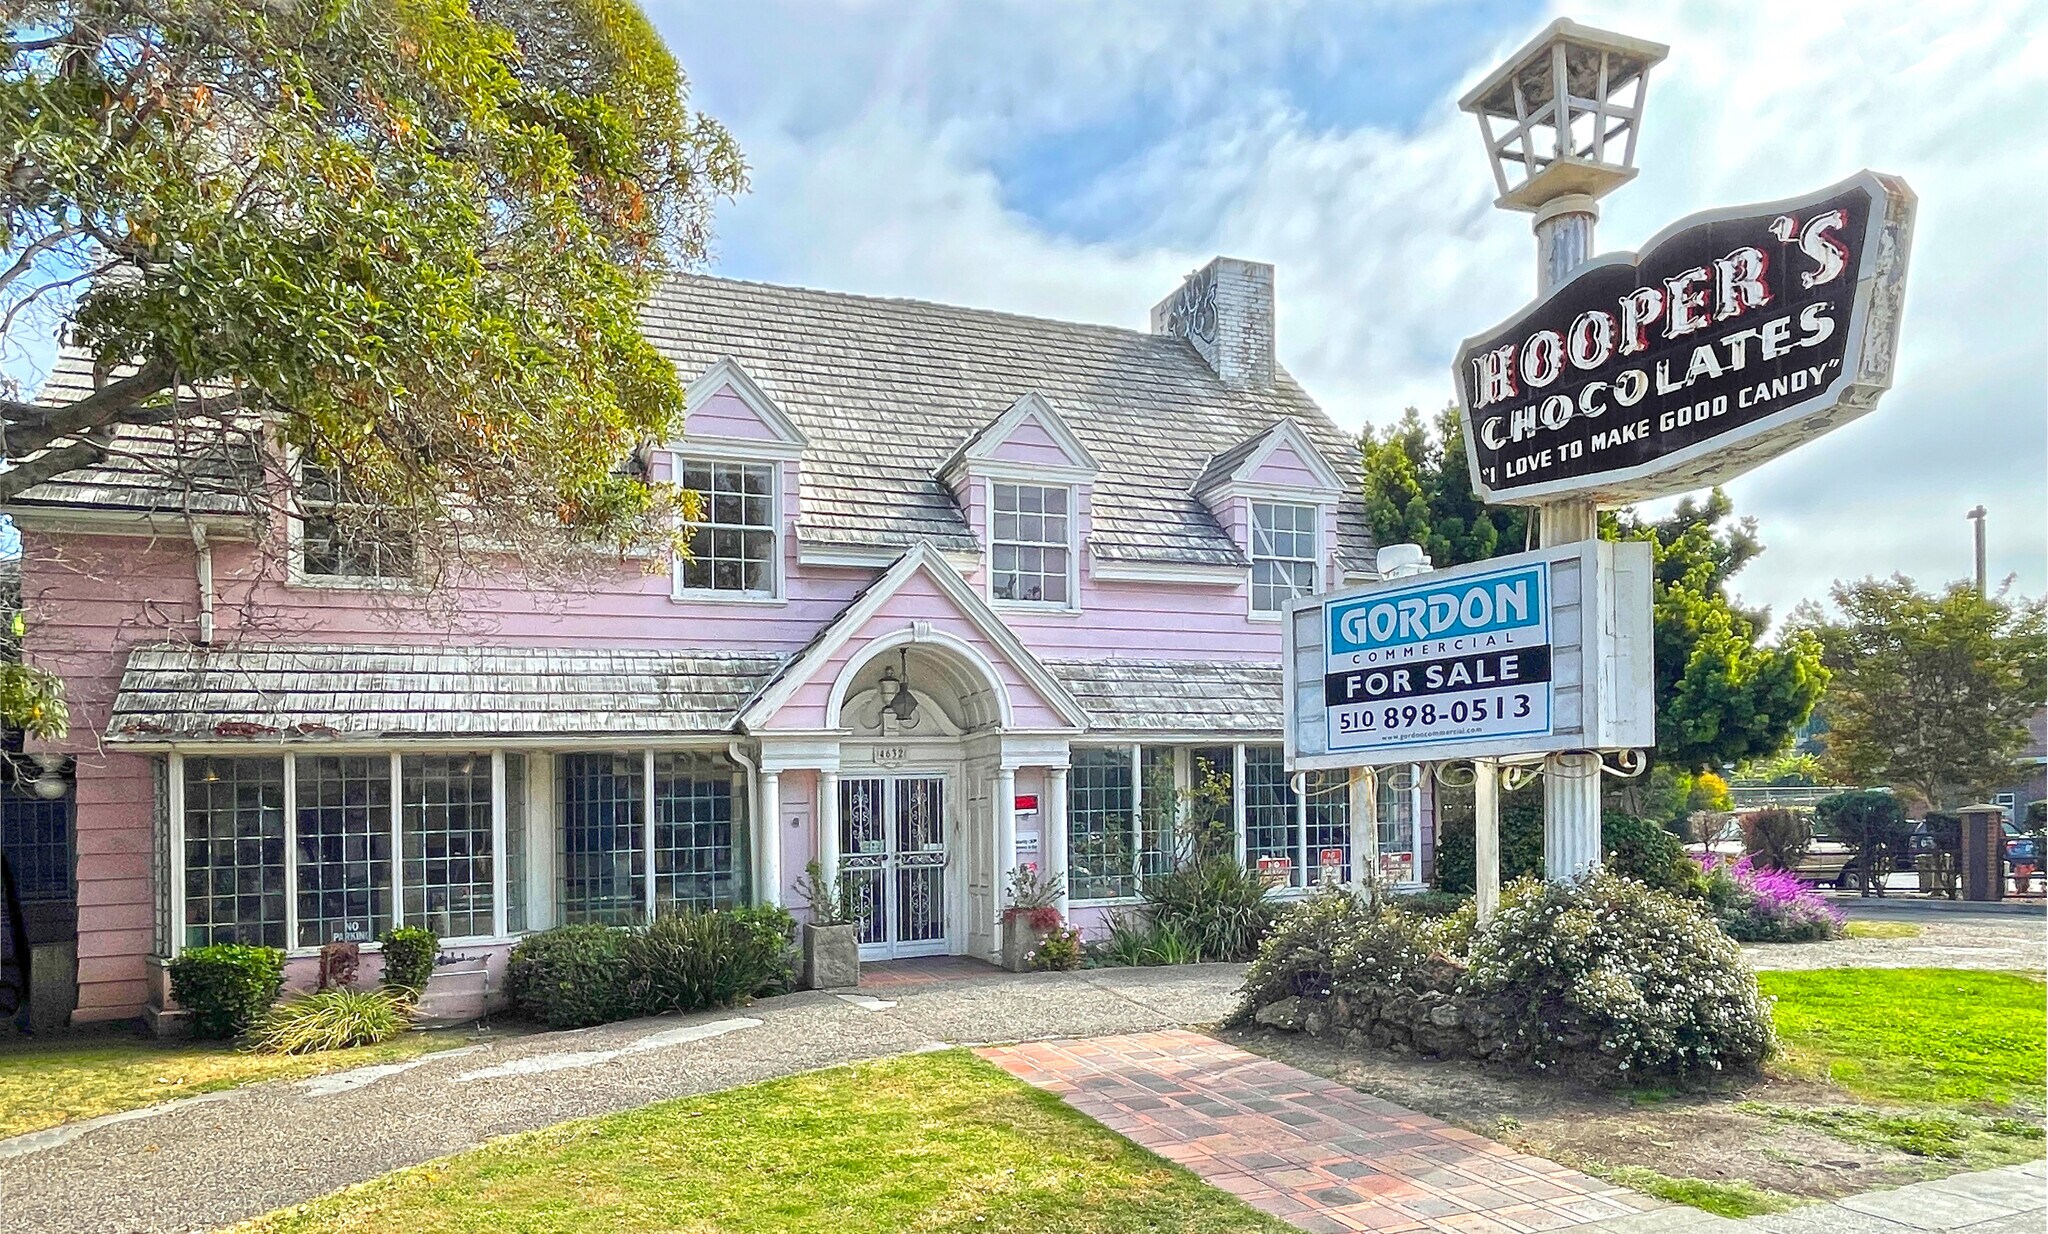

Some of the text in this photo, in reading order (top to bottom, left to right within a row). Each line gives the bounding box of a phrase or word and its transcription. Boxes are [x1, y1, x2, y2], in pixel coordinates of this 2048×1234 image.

[1472, 208, 1849, 409] HOOPER'S
[1481, 301, 1836, 451] CHOCOLATES
[1506, 451, 1553, 478] LOVE
[1558, 440, 1583, 462] TO
[1591, 418, 1650, 453] MAKE
[1659, 397, 1729, 433] GOOD
[1340, 579, 1529, 645] GORDON
[1352, 632, 1515, 664] COMMERCIAL
[1346, 654, 1520, 697] FOR SALE
[1340, 694, 1531, 731] 510 898-0513
[879, 748, 904, 759] 4632
[1381, 726, 1483, 741] www.gordoncommercial.com
[345, 921, 359, 931] NO
